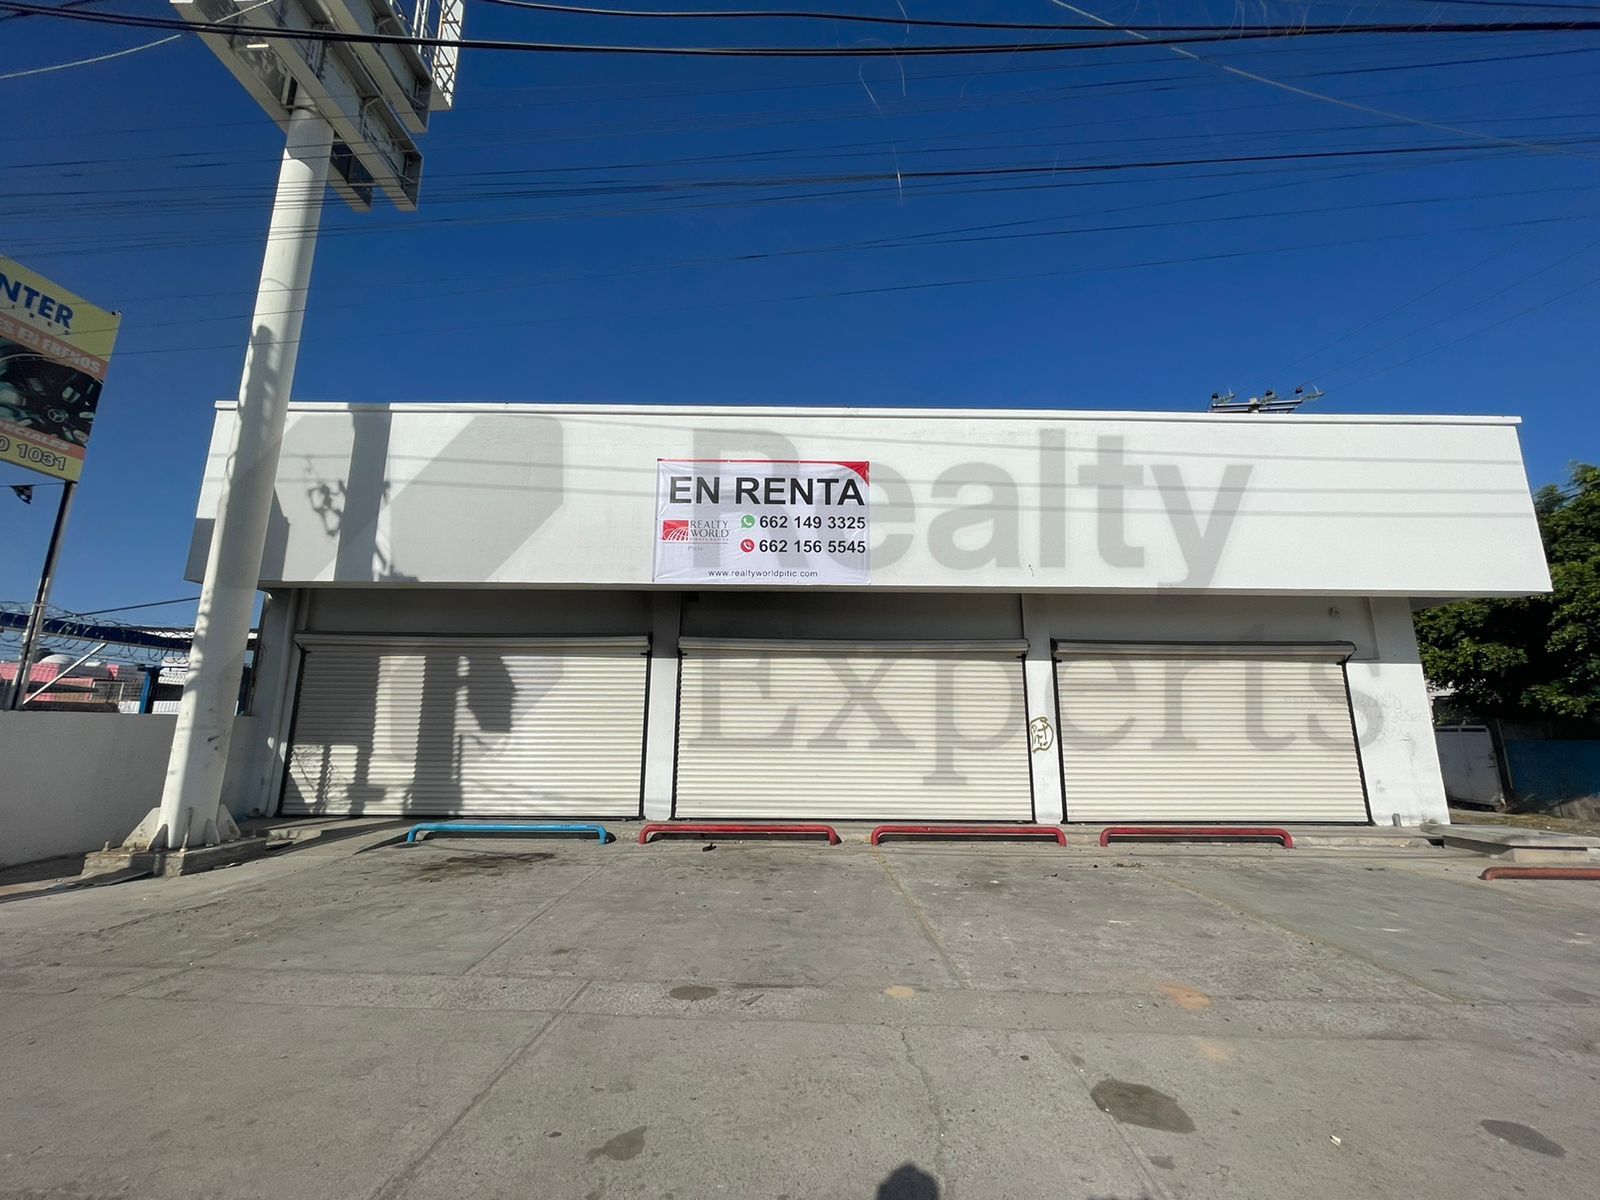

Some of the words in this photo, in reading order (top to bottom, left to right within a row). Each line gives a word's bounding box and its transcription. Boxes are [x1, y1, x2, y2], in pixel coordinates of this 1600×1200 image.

[0, 272, 73, 329] NTER
[42, 337, 101, 374] FRENOS
[16, 443, 67, 471] 1031
[669, 476, 720, 504] EN
[735, 477, 865, 506] RENTA
[690, 520, 729, 529] REALTY
[759, 516, 788, 529] 662
[794, 516, 822, 529] 149
[827, 516, 866, 529] 3325
[690, 529, 730, 538] WORLD
[759, 540, 788, 553] 662
[794, 540, 822, 553] 156
[827, 540, 866, 553] 5545
[708, 569, 818, 578] www.realtyworldpitic.com
